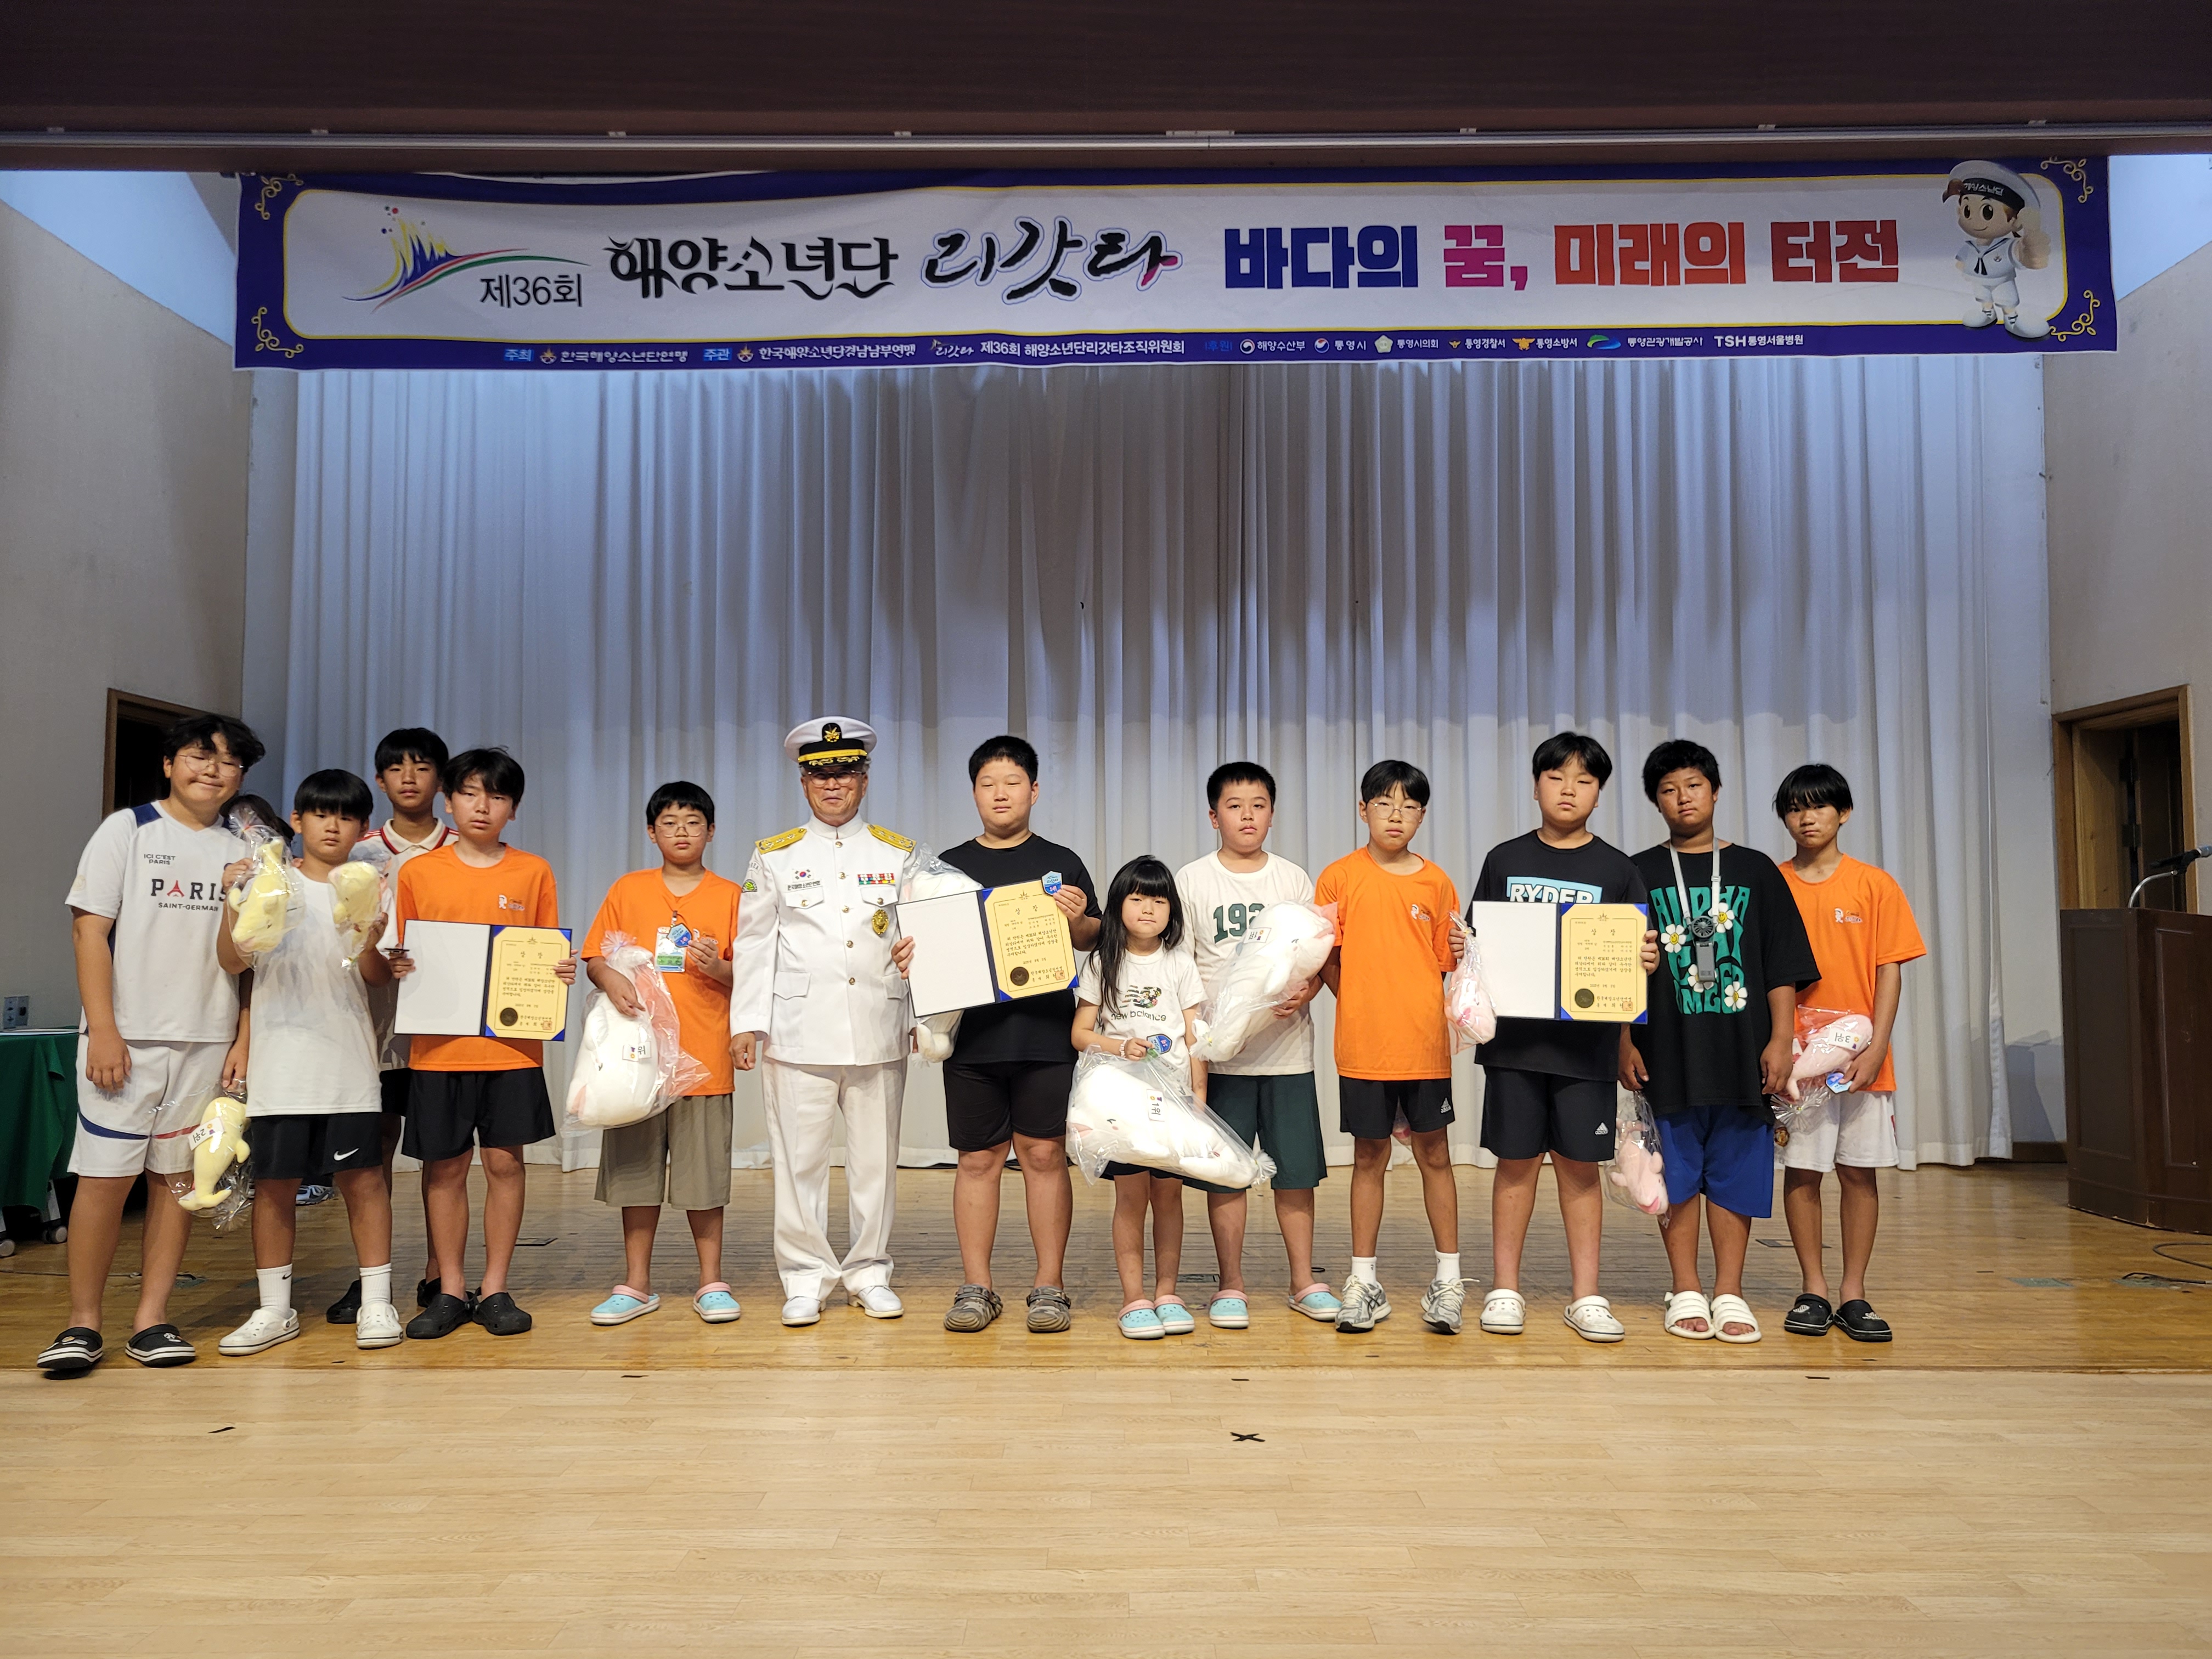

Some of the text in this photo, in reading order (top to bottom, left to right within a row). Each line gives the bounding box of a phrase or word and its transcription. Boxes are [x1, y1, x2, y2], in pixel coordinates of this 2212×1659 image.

[480, 219, 1899, 308] 제36회 해양소년단 리갓타 바다의 꿈, 미래의 터전
[1256, 340, 1306, 352] 해양수산부
[1334, 340, 1367, 351] 통영시
[1397, 338, 1439, 349] 통영시의회
[1464, 338, 1506, 349] 통영경찰서
[1536, 337, 1578, 348] 통영소방서
[1627, 336, 1703, 348] 통영관광개발공사
[1714, 334, 1804, 347] TSH 통영서울병원
[703, 344, 916, 361] 주관 한국해양소년단경남남부연맹
[980, 341, 1021, 357] 제36회
[1024, 340, 1185, 358] 해양소년단리갓타조직위원회
[560, 351, 689, 364] 한국해양소년단연맹
[1835, 1032, 1850, 1043] 3위
[1151, 1103, 1161, 1115] 1위
[193, 1128, 206, 1143] 2위
